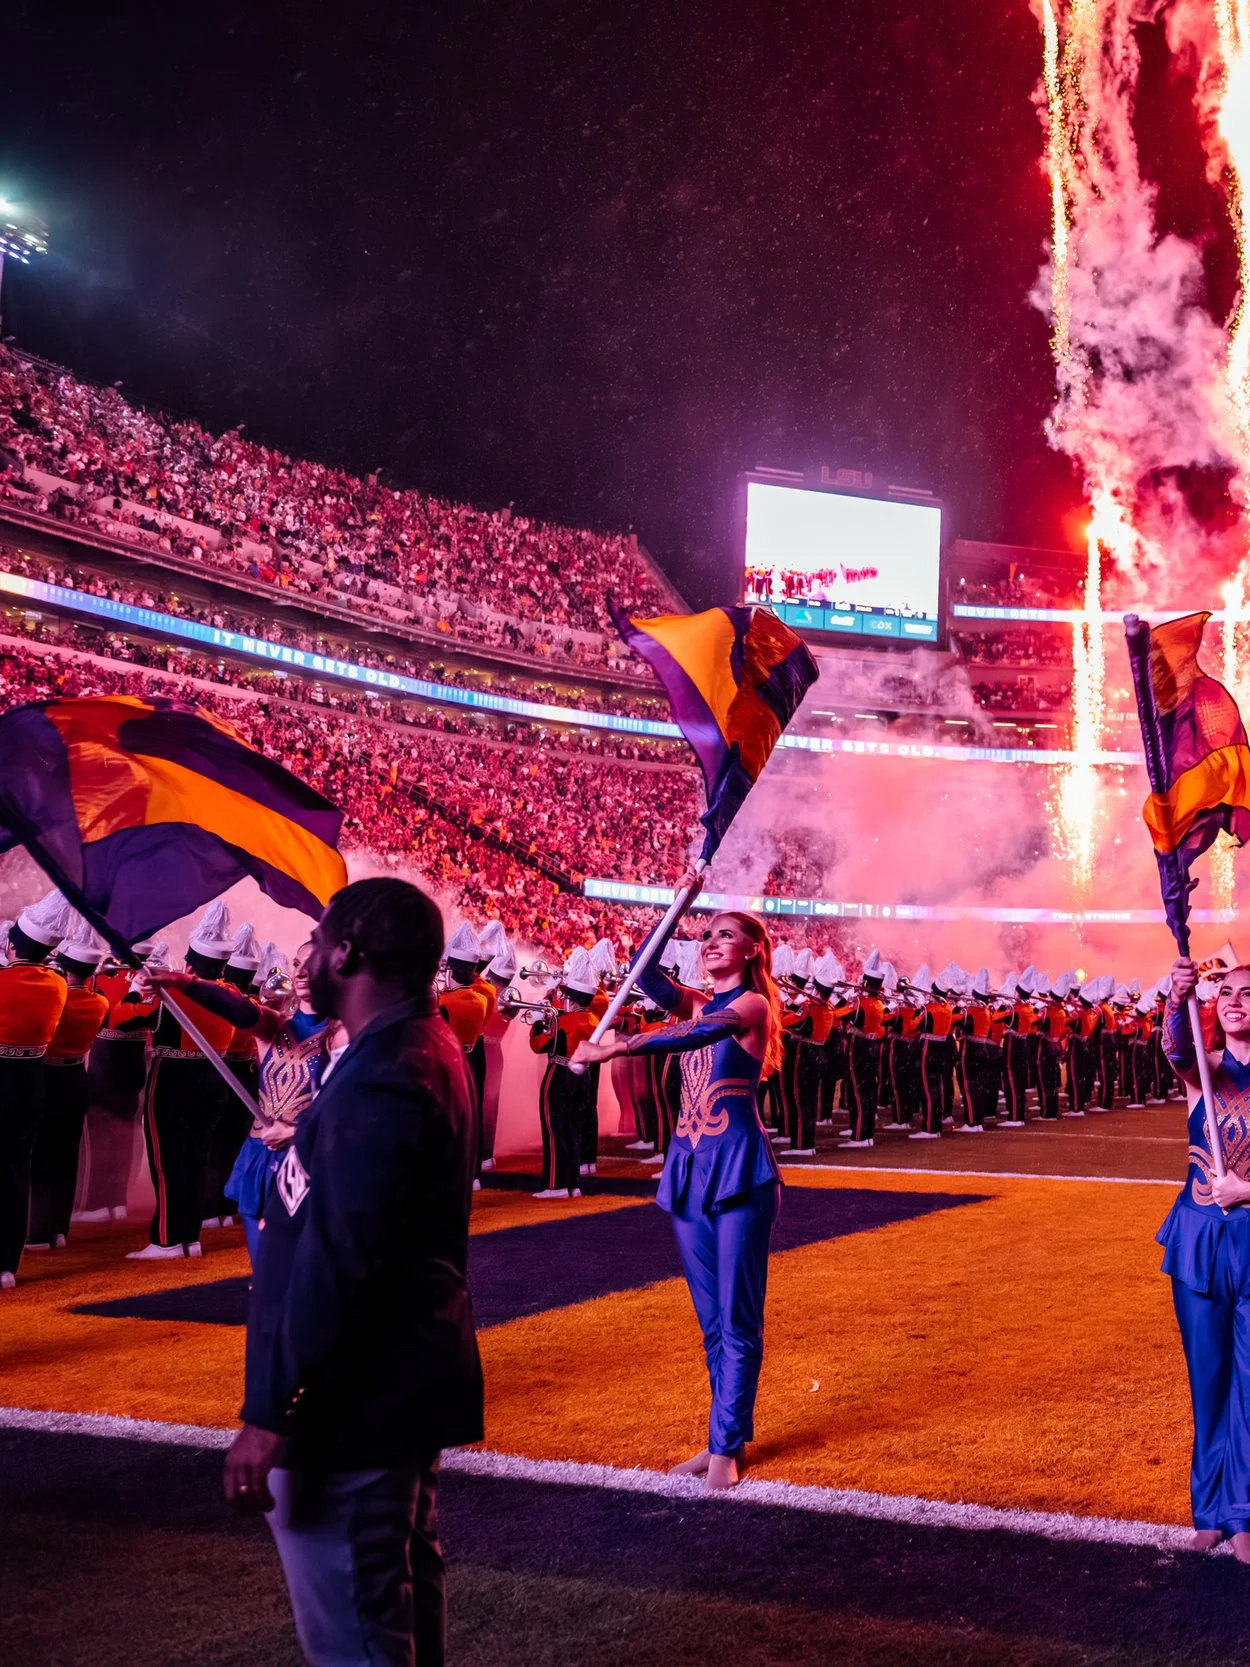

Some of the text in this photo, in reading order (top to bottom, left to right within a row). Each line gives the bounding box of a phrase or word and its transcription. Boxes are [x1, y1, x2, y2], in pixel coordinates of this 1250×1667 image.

[821, 466, 873, 489] LSU
[214, 630, 406, 689] IT NEVER GETS OLD.
[841, 739, 890, 754] GETS
